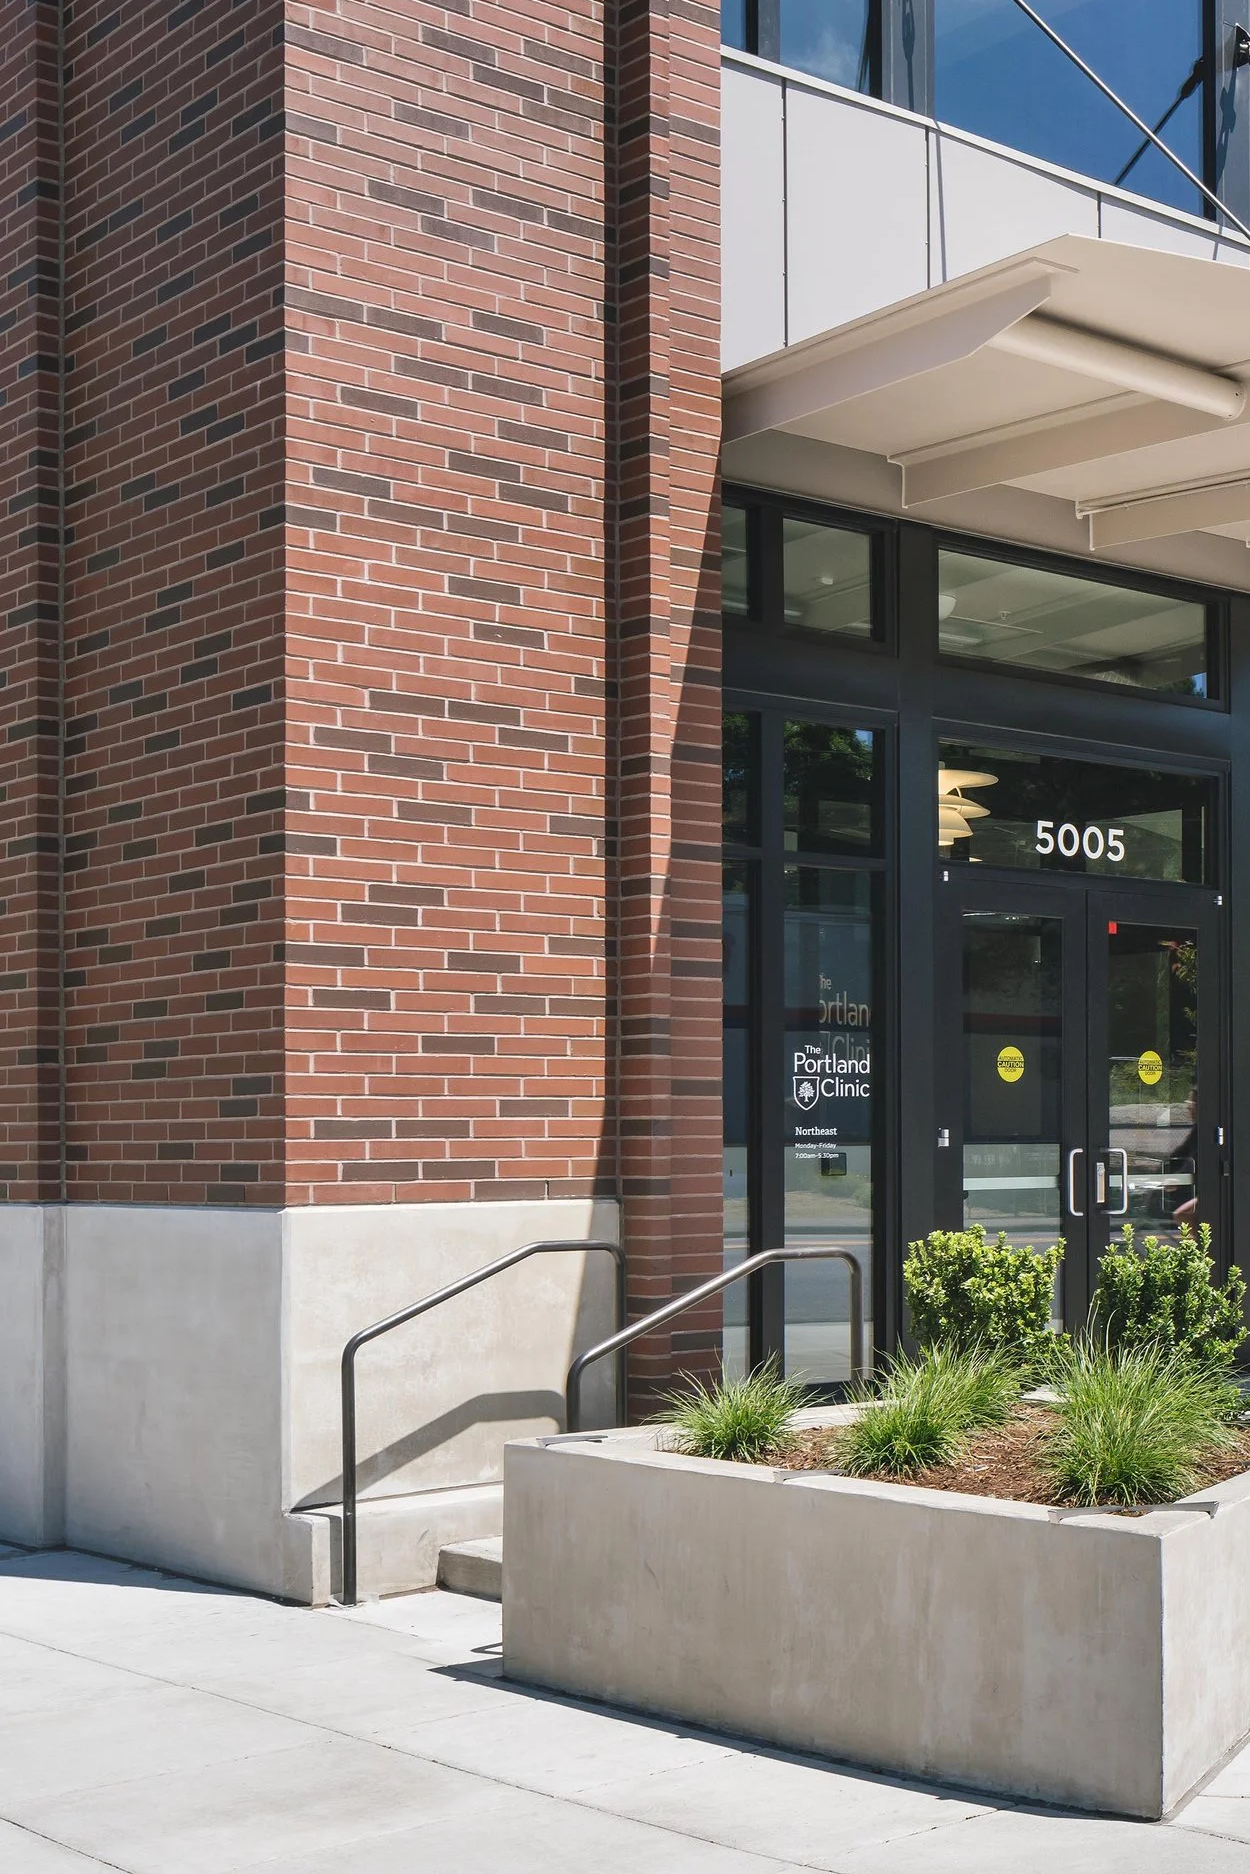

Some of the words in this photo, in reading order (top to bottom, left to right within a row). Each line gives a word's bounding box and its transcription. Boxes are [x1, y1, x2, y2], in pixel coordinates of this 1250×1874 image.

[1035, 820, 1125, 862] 5005
[804, 1044, 821, 1055] The
[794, 1053, 870, 1074] Portland
[821, 1079, 870, 1098] Clinic
[795, 1126, 838, 1136] Northeast
